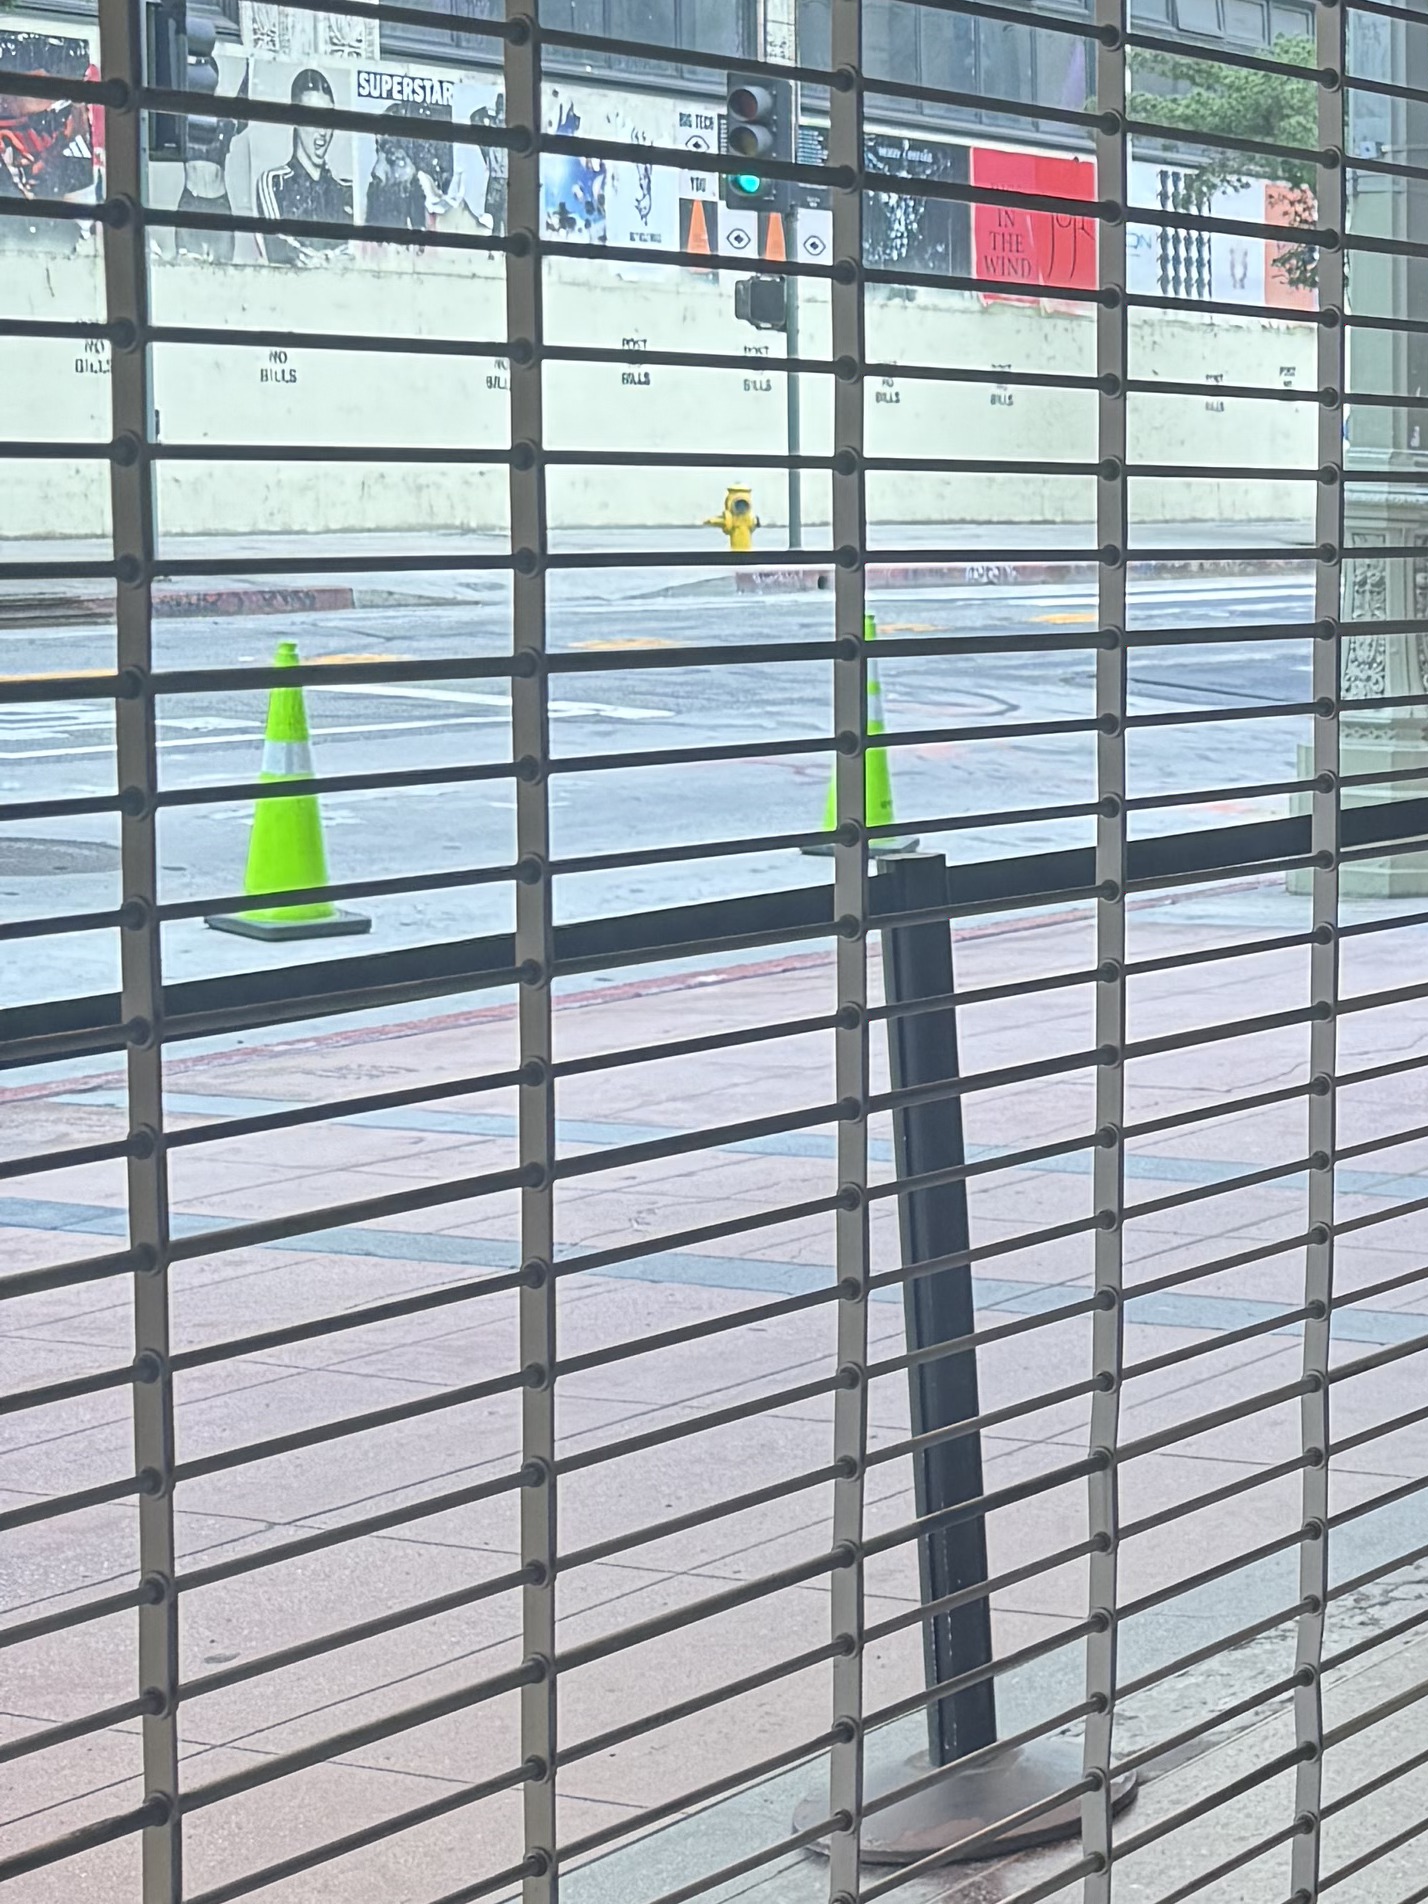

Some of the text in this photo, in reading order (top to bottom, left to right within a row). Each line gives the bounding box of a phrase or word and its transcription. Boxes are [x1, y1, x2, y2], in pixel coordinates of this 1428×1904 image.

[358, 71, 454, 105] SUPERSTAR
[997, 207, 1016, 228] IN
[989, 230, 1025, 253] THE
[983, 254, 1032, 278] WIND
[84, 339, 105, 354] NO
[268, 350, 288, 364] NO
[260, 367, 297, 384] BILLS
[621, 371, 651, 386] BILLS
[743, 378, 772, 392] BILLS
